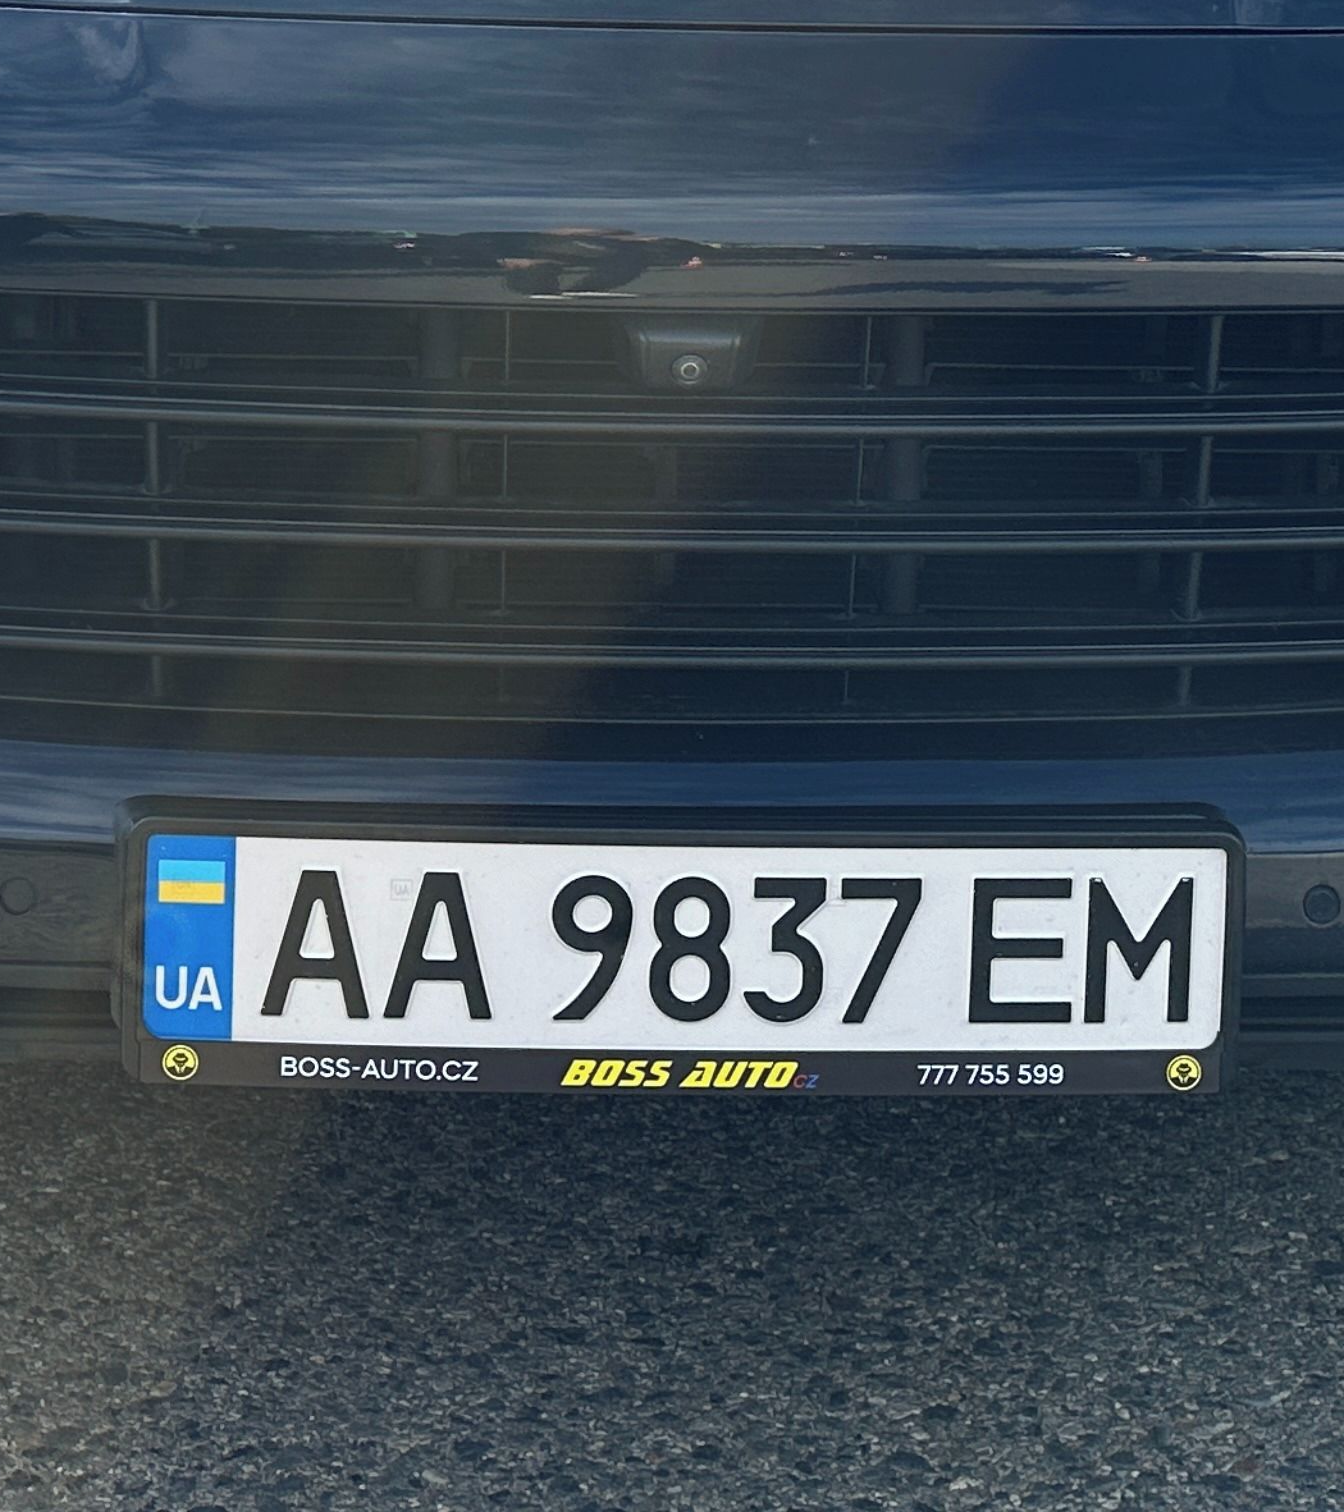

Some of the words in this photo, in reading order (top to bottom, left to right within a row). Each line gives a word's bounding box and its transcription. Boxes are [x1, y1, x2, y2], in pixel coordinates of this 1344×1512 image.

[259, 868, 493, 1020] AA
[551, 874, 923, 1024] 9837
[967, 876, 1195, 1024] EM
[154, 964, 223, 1012] UA
[279, 1055, 480, 1083] BOSS-AUTO.CZ
[559, 1058, 674, 1088] BOSS
[678, 1059, 800, 1089] AUTO
[916, 1063, 959, 1086] 777
[964, 1063, 1010, 1086] 755
[1016, 1063, 1065, 1086] 599
